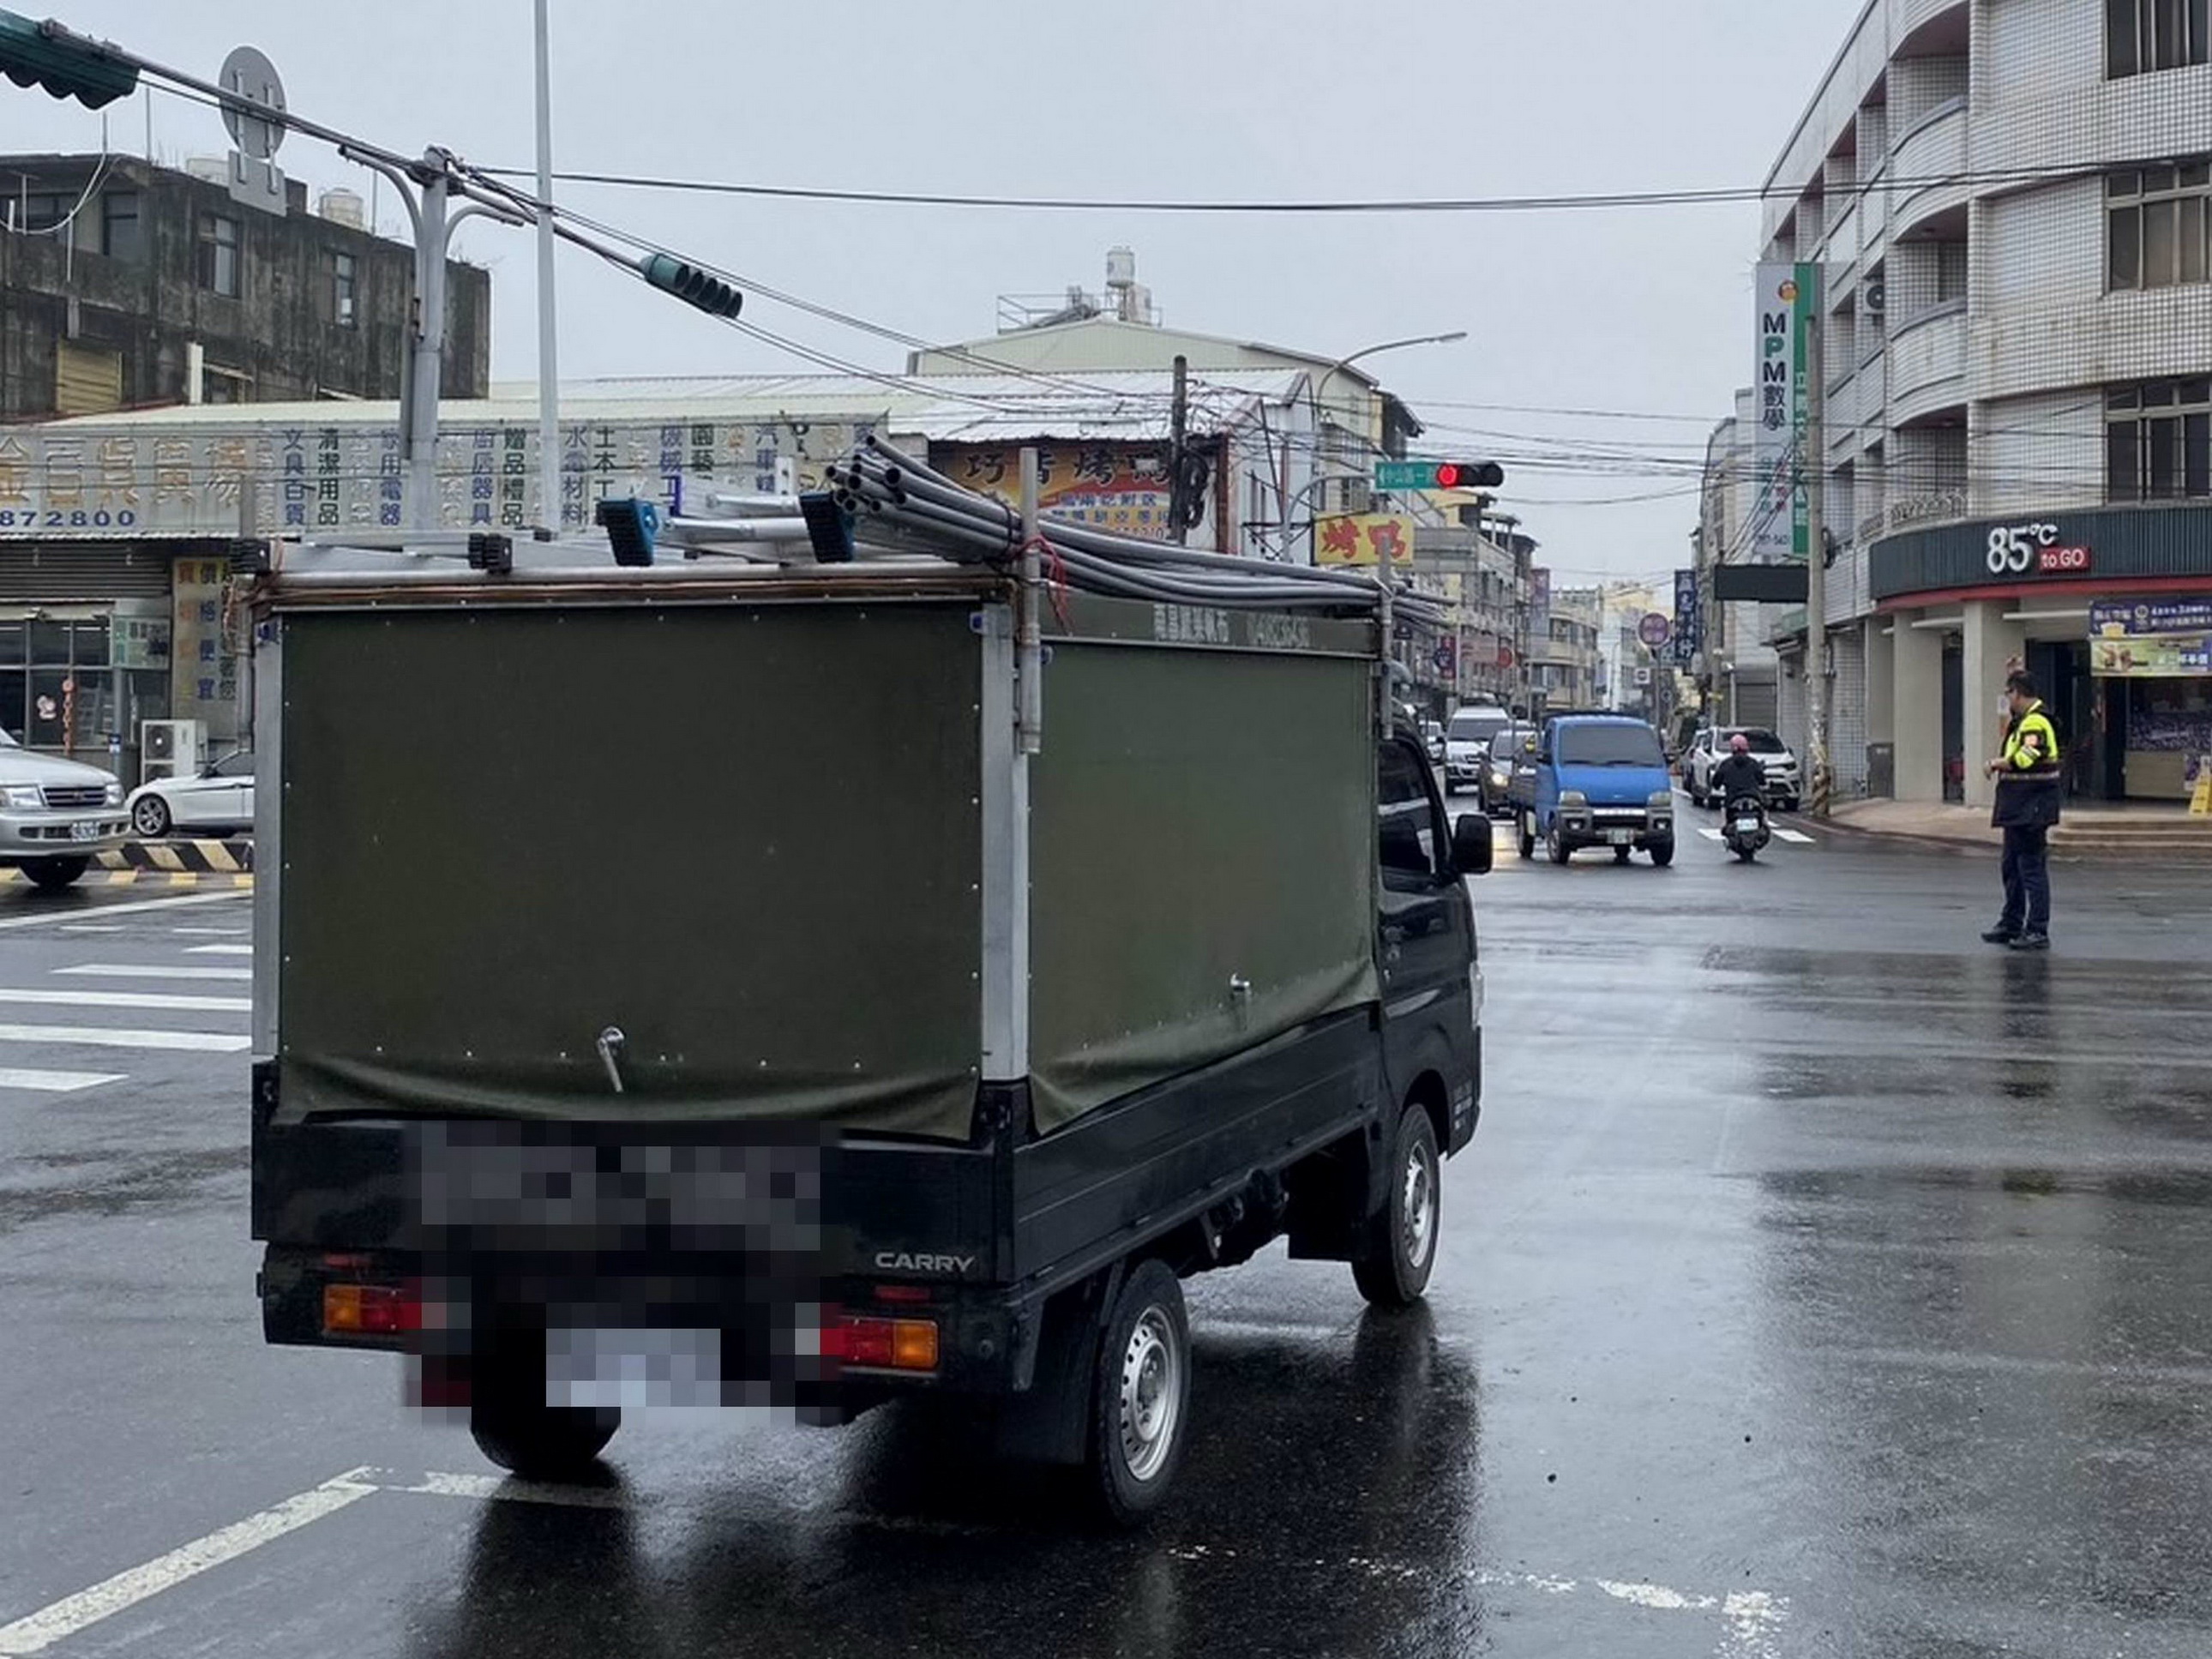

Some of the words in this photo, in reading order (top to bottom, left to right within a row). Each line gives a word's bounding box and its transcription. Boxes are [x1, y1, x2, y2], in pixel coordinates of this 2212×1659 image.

[1763, 312, 1787, 430] MPM數學
[283, 428, 304, 526] 文具百貨
[318, 427, 340, 526] 清潔用品
[0, 509, 135, 527] 872800
[2041, 553, 2057, 568] to
[2060, 549, 2085, 567] GO
[875, 1252, 976, 1273] CARRY
